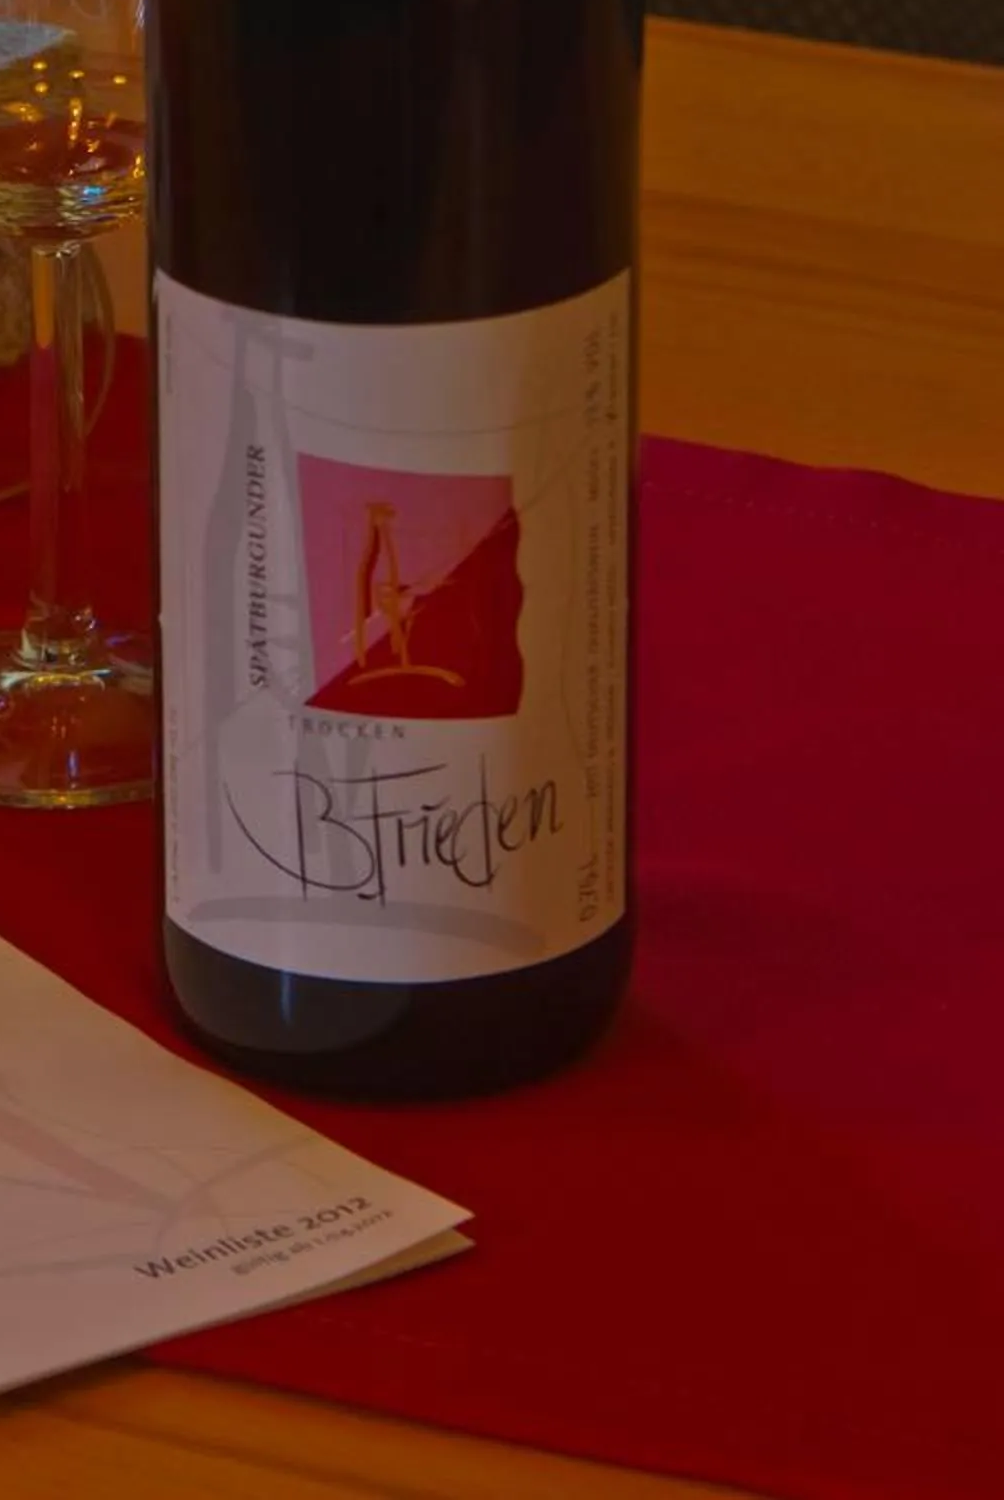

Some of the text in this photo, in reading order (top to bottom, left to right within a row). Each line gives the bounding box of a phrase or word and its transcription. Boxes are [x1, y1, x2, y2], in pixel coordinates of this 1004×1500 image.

[289, 713, 406, 740] TROCKEN
[133, 1196, 373, 1279] Weinliste 2012
